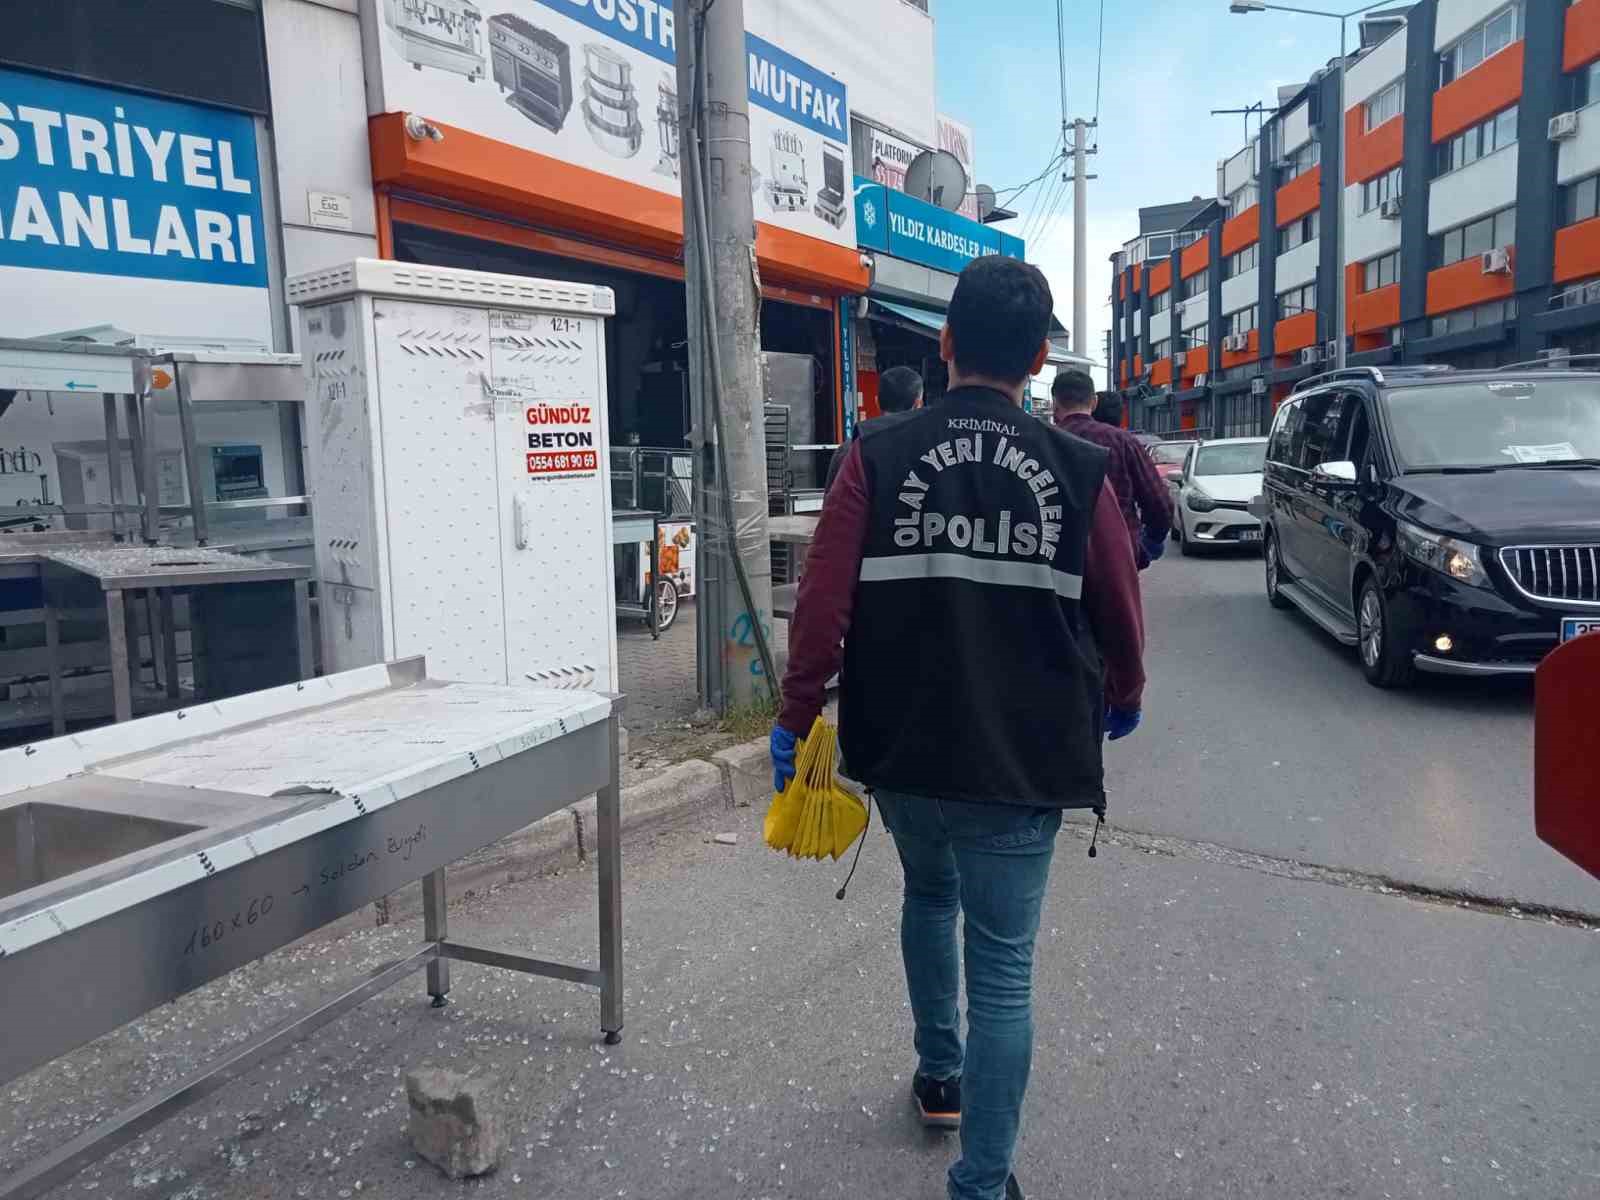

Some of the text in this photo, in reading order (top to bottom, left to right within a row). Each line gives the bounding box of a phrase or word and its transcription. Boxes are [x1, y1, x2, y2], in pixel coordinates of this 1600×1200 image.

[749, 53, 842, 131] MUTFAK
[0, 185, 256, 265] ANLARI
[889, 211, 980, 259] YILDIZ KARDEŞLER
[527, 402, 592, 425] GÜNDÜZ
[528, 431, 593, 449] BETON
[530, 455, 553, 470] 0554
[555, 455, 570, 469] 681
[571, 454, 583, 468] 90
[894, 432, 1063, 561] OLAY YERİ İNCELEME
[923, 510, 1039, 557] POLİS
